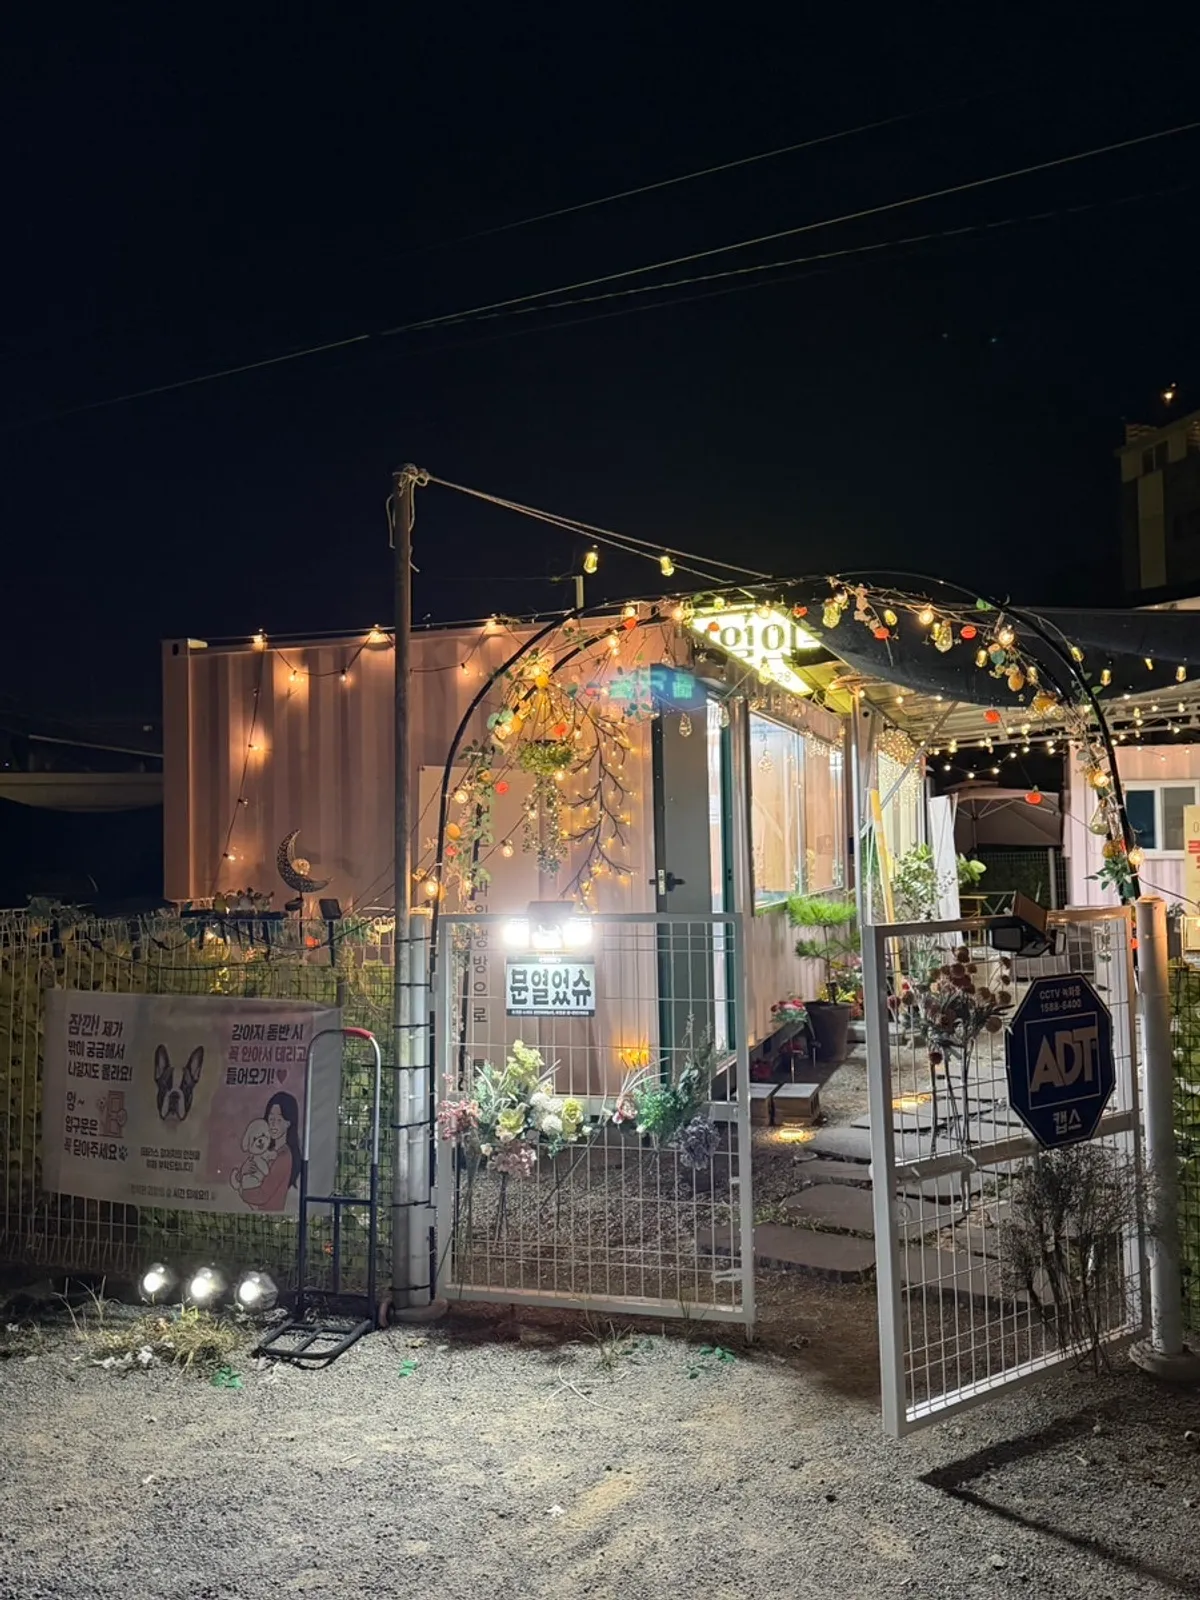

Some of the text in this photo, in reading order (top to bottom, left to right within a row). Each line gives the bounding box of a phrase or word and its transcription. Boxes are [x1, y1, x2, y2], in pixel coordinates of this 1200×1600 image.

[510, 968, 592, 1006] 문열었슈
[1039, 988, 1061, 1000] CCTV
[68, 1013, 123, 1038] 잠깐! 제가
[232, 1024, 304, 1041] 강아지 동반 시
[87, 1041, 125, 1060] 궁금해서
[228, 1045, 308, 1063] 꼭 안아서 데리고
[1030, 1026, 1099, 1093] ADT
[68, 1060, 133, 1081] 나갈지도 몰라요!
[226, 1066, 276, 1085] 들어오기!
[1053, 1108, 1082, 1135] 캡스
[73, 1138, 117, 1160] 닫아주세요
